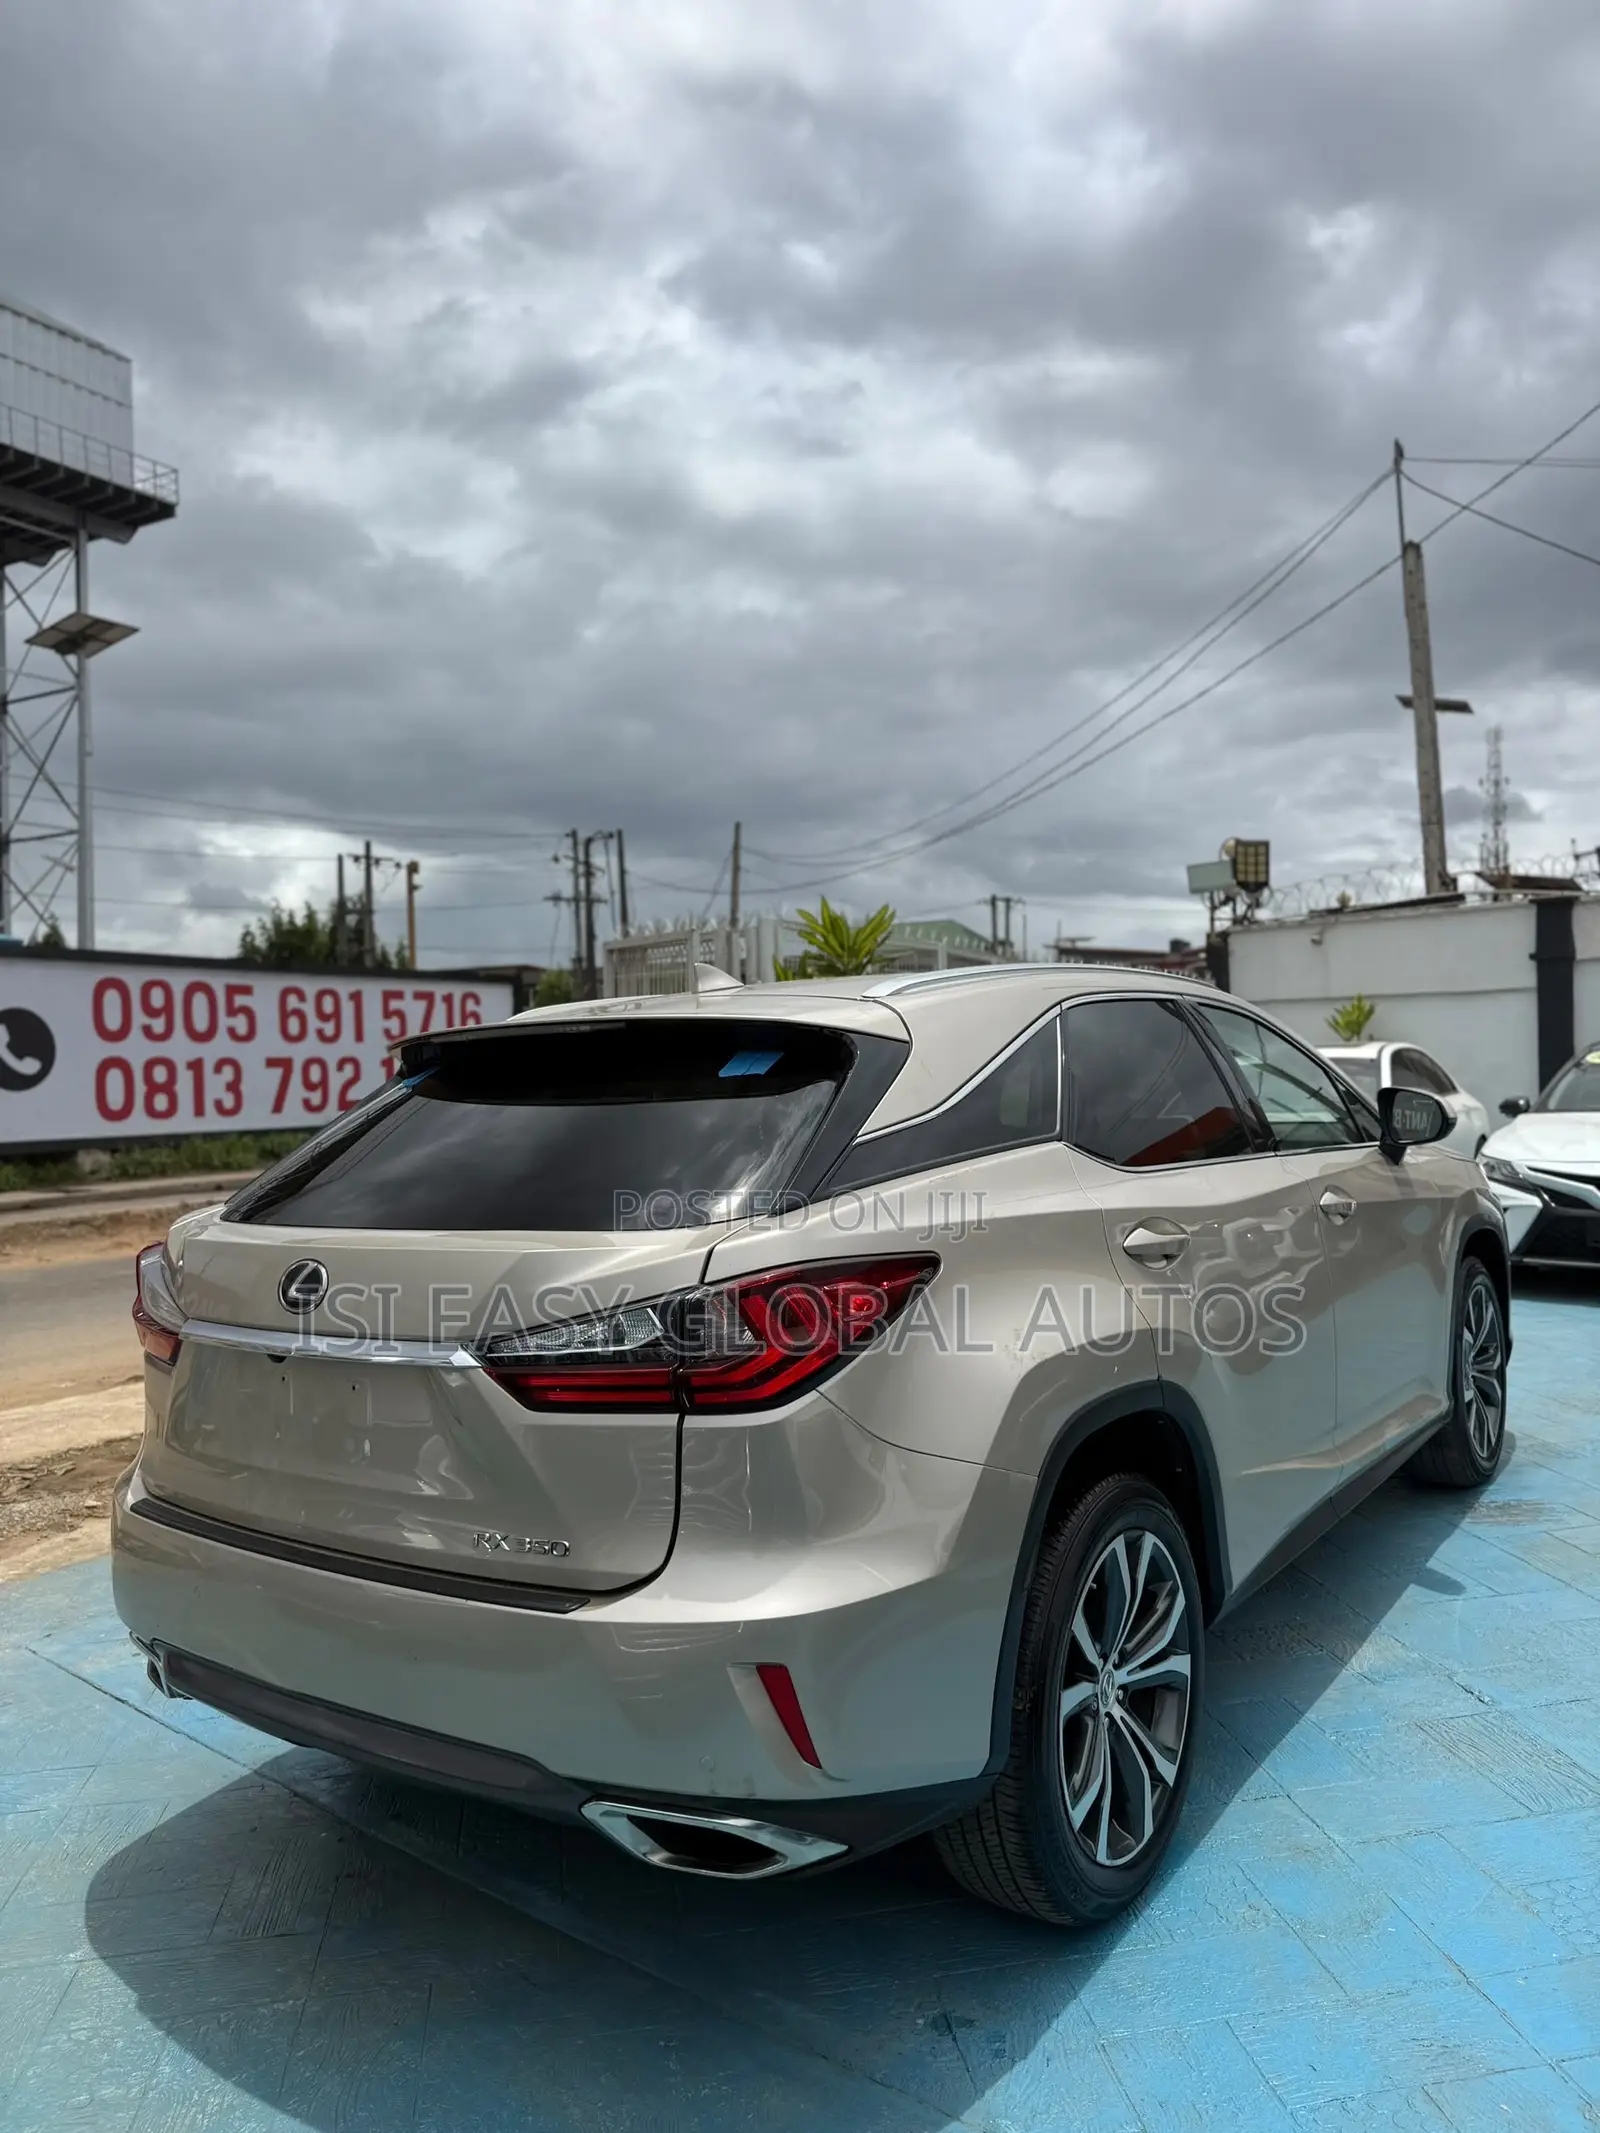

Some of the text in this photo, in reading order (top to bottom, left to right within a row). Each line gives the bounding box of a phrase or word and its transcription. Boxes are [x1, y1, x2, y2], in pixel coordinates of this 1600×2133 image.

[92, 977, 482, 1043] 0905 691 5716
[95, 1056, 244, 1122] 0813
[265, 1056, 361, 1115] 792
[472, 1531, 571, 1557] RX 350
